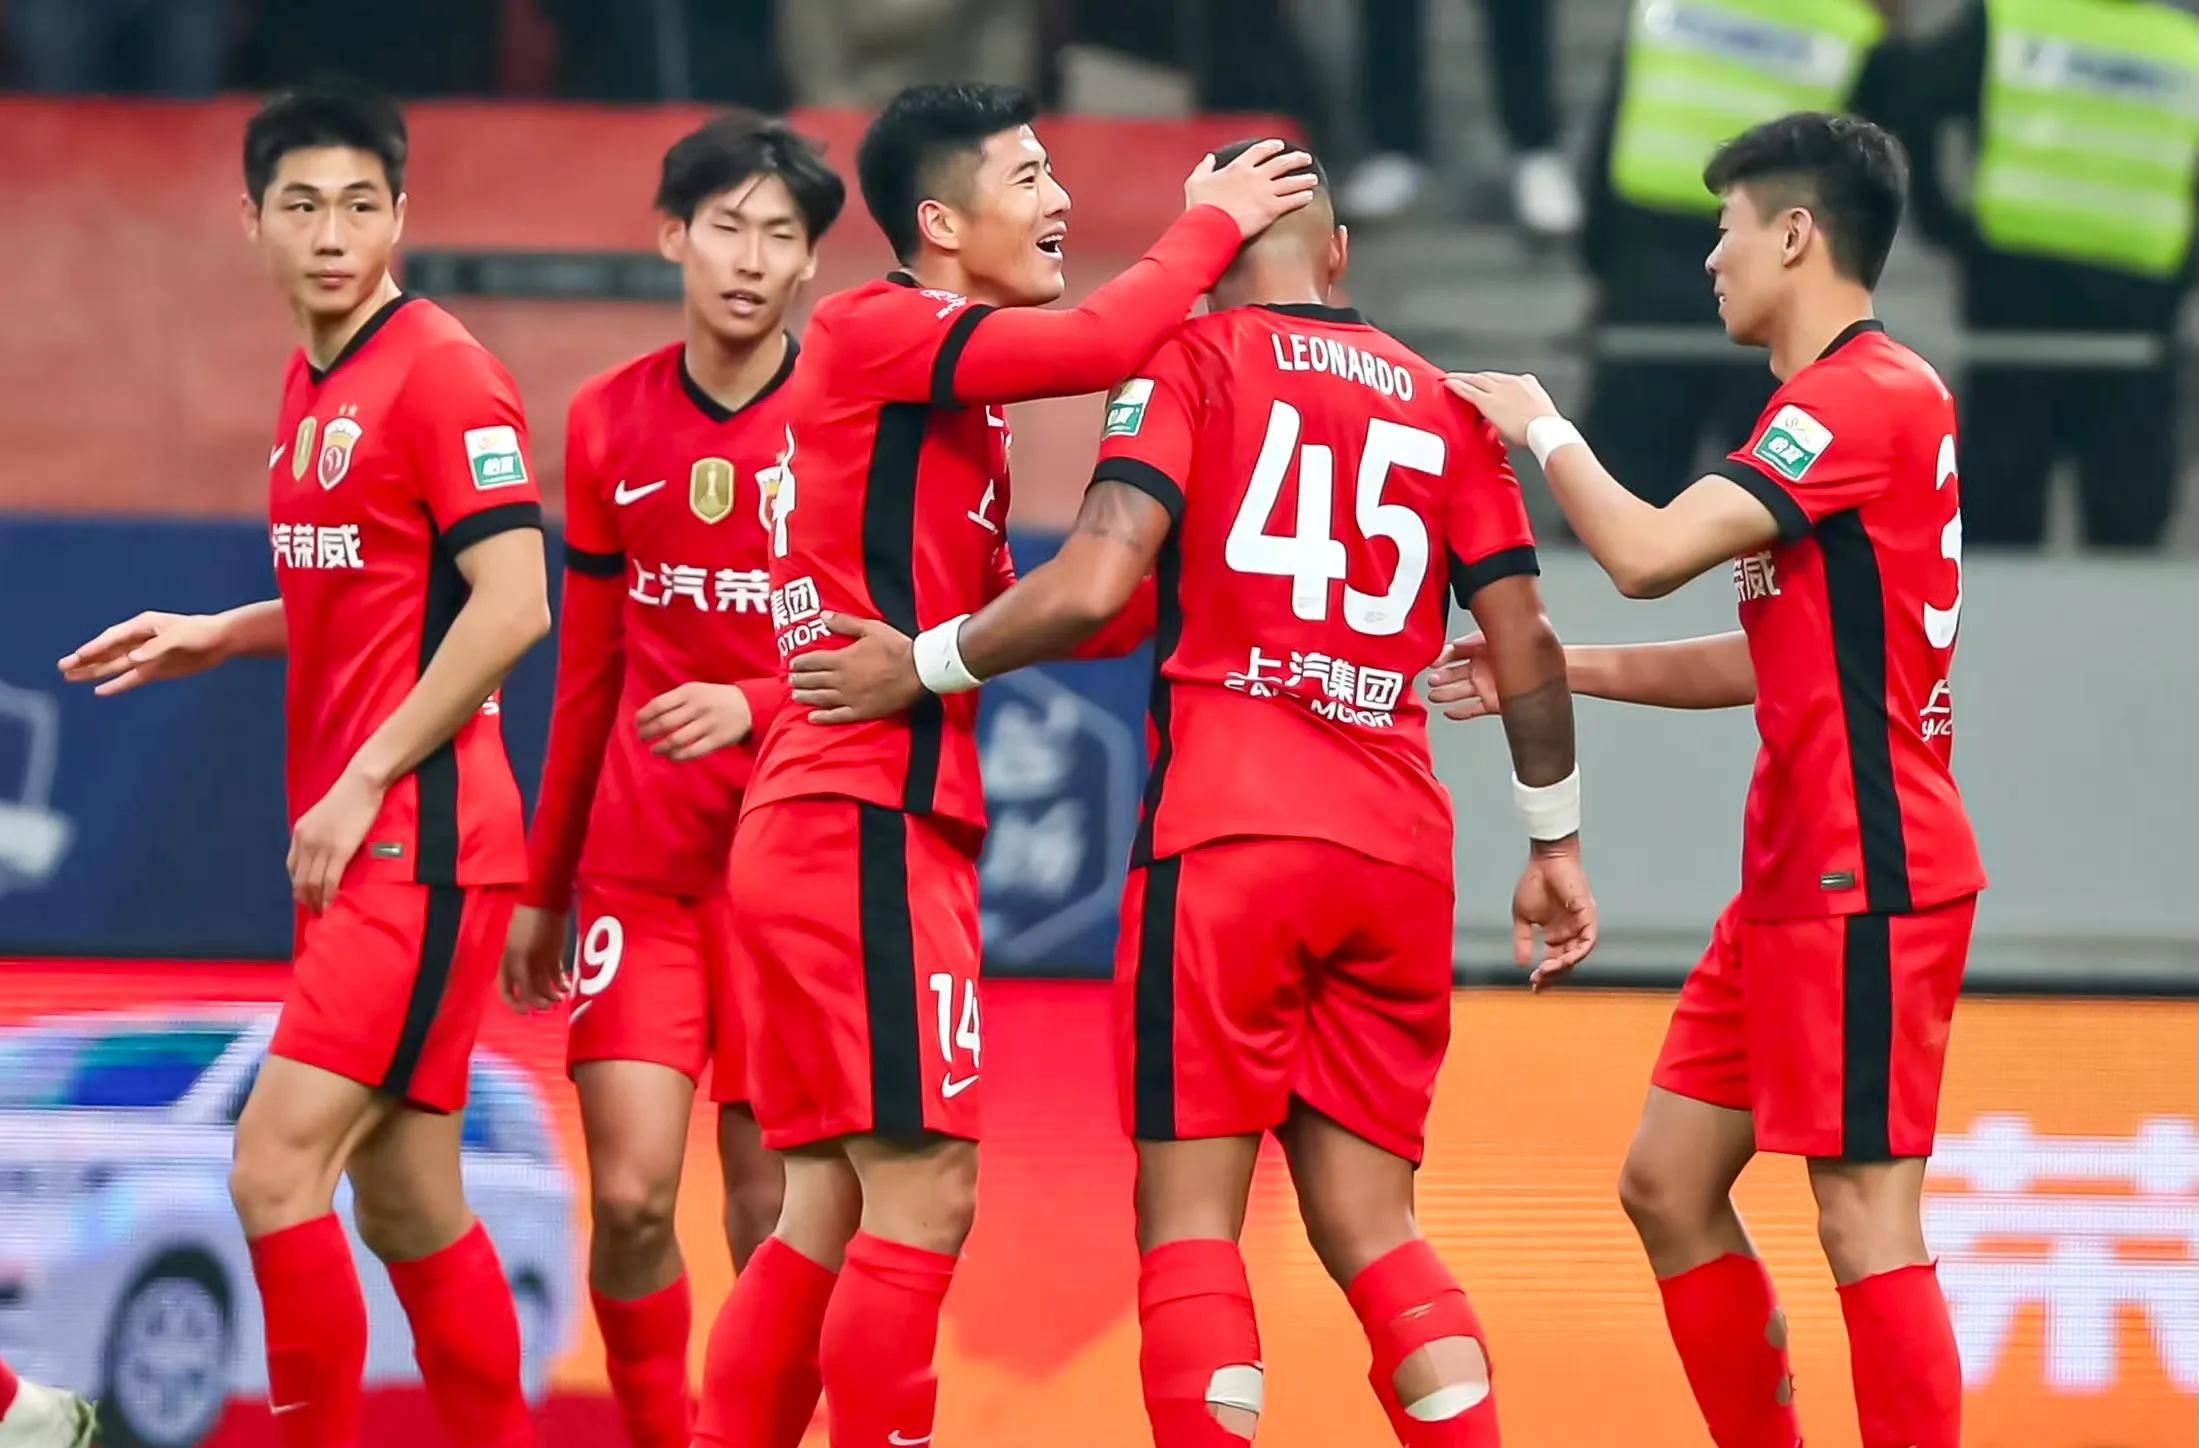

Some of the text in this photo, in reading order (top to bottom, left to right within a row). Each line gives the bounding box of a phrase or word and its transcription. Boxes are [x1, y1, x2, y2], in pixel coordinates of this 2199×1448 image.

[1270, 332, 1414, 401] LEONARDO
[1224, 399, 1446, 637] 45
[628, 558, 771, 614] 上汽荣
[1244, 646, 1404, 711] 上汽集团
[928, 971, 980, 1070] 14
[1920, 1108, 2199, 1396] 荣
